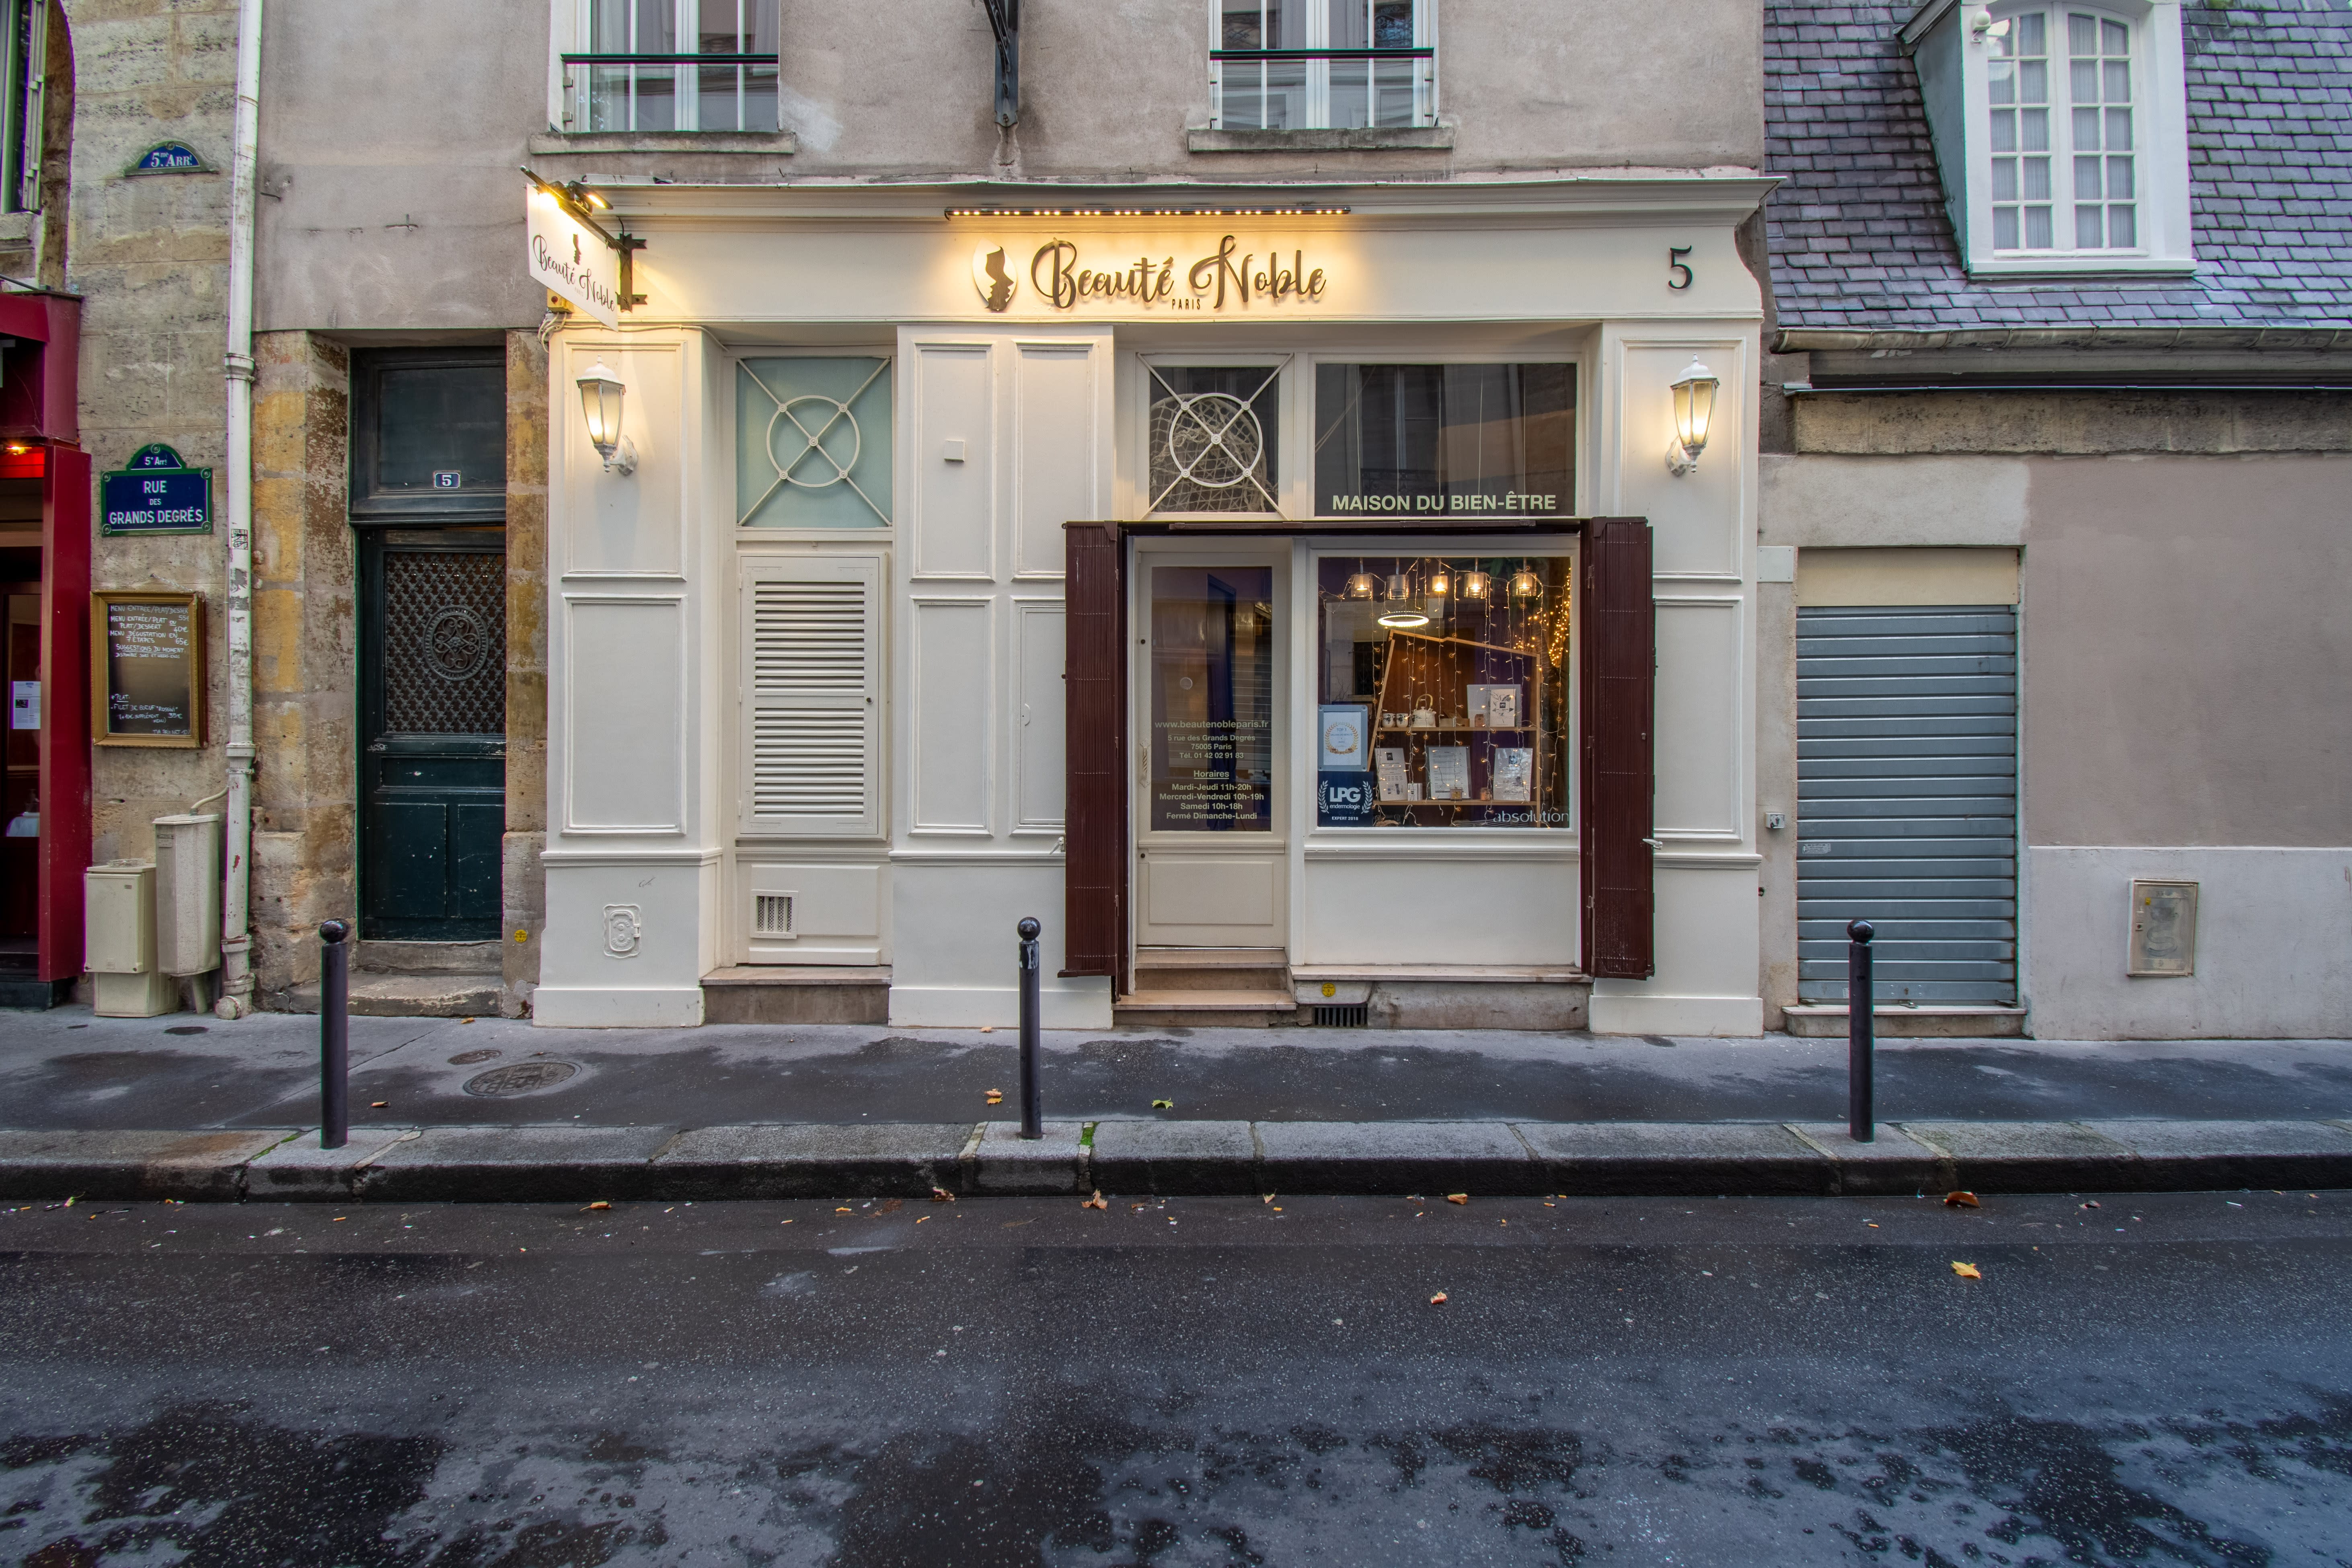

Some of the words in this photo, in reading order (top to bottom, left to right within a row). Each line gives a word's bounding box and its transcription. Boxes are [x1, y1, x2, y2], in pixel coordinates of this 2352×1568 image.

[533, 233, 575, 284] Beauté
[579, 268, 615, 312] Noble
[1031, 237, 1175, 309] Beauté
[1189, 235, 1327, 309] Noble
[1668, 245, 1693, 290] 5
[1172, 299, 1200, 310] PARIS
[144, 481, 167, 493] RUE
[442, 475, 452, 486] 5
[1333, 495, 1409, 510] MAISON
[1417, 495, 1444, 510] DU
[1451, 491, 1556, 510] BIEN-ÊTRE
[109, 510, 155, 524] GRANDS
[157, 506, 203, 523] DEGRÉS
[176, 637, 189, 646] 65€
[1154, 720, 1268, 729] www.beautenobleparis.fr
[1330, 787, 1361, 803] LPG
[1493, 810, 1569, 822] absolution
